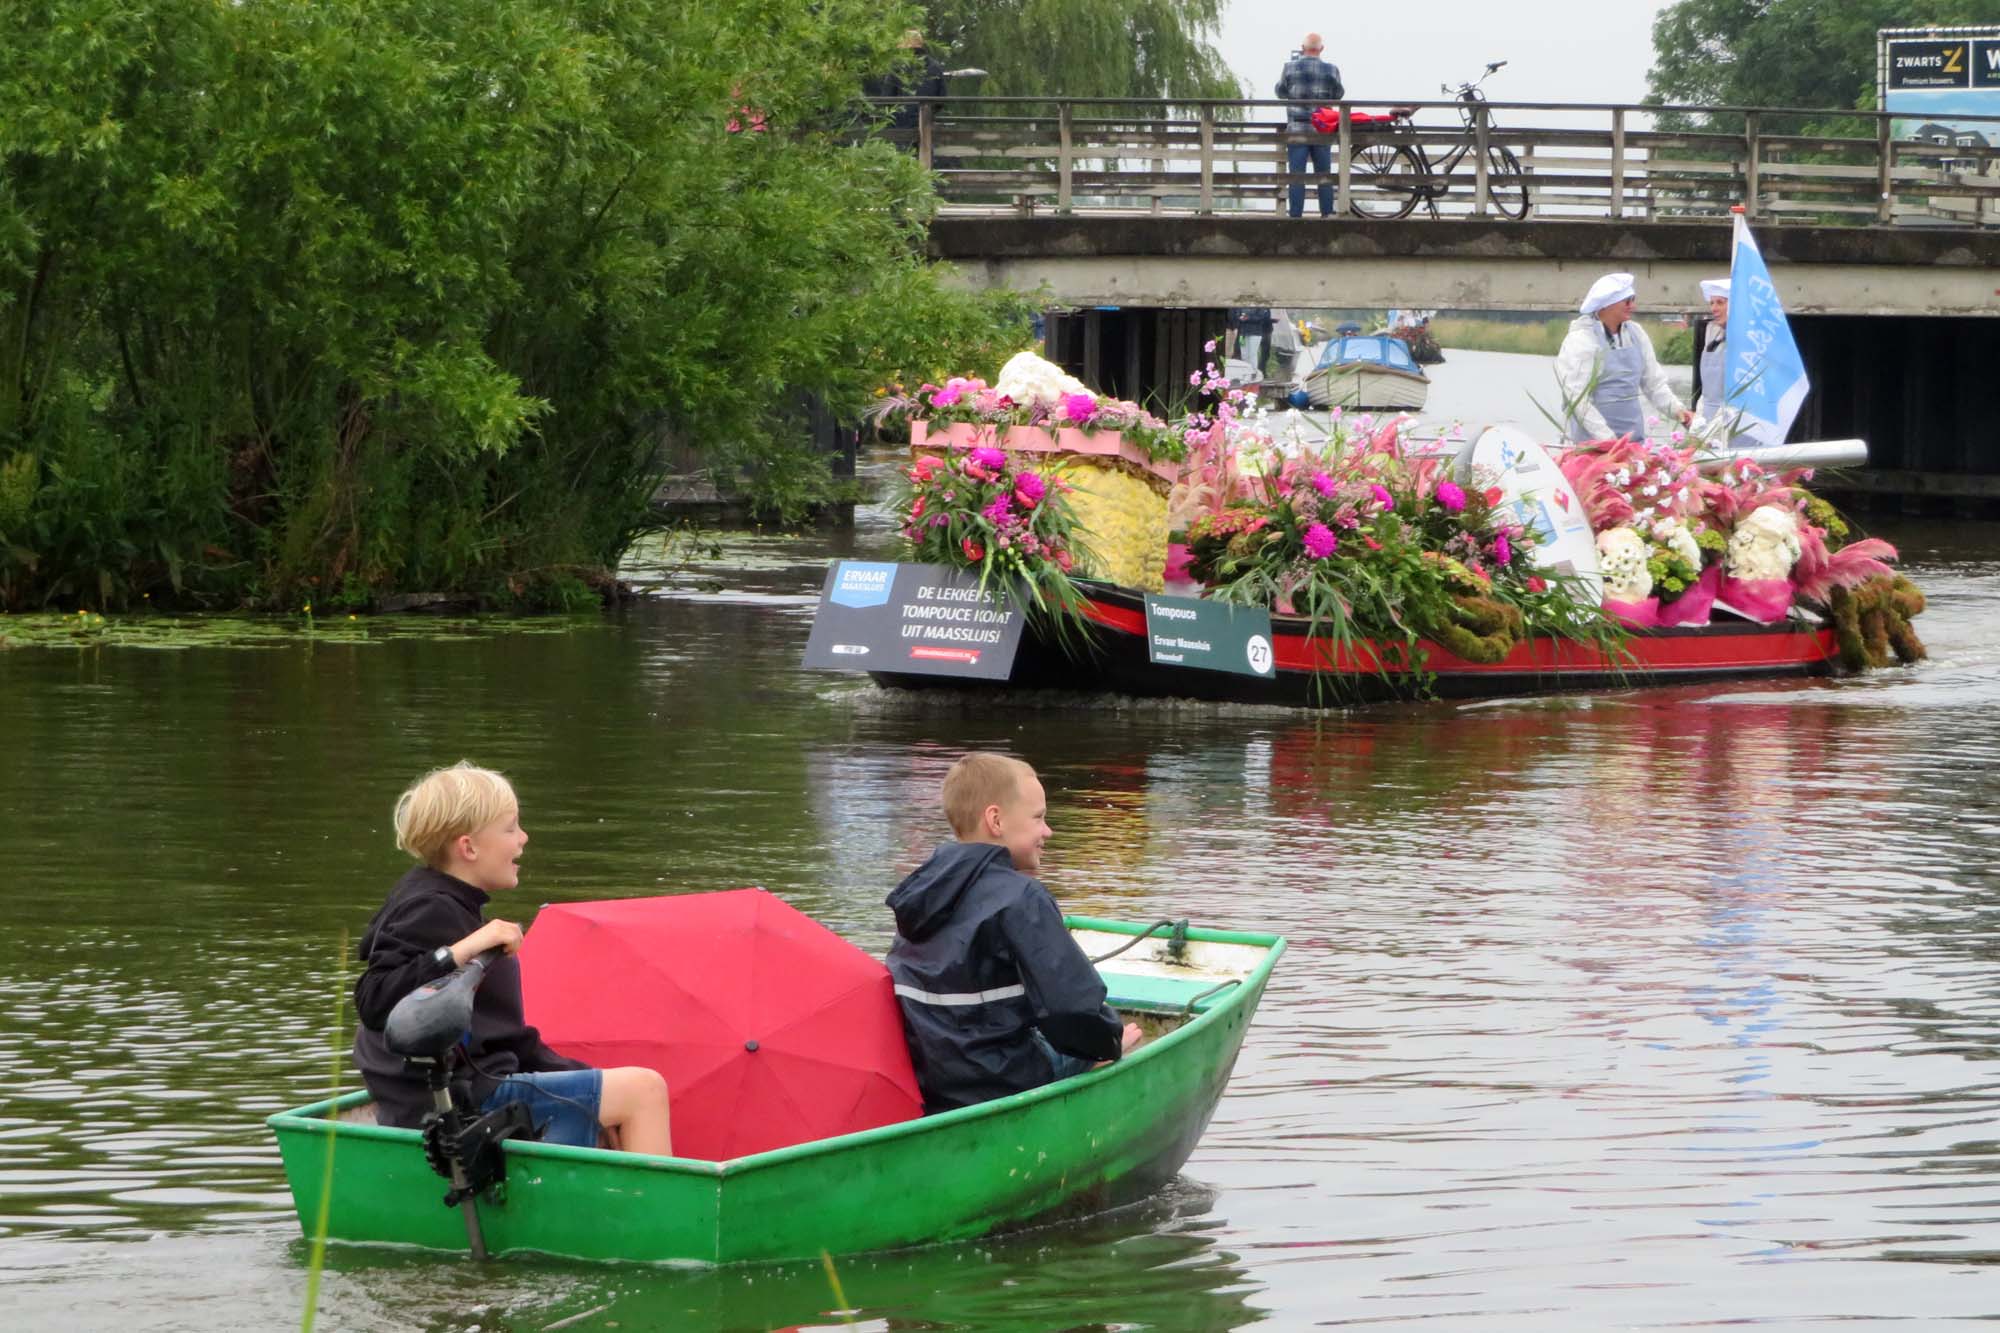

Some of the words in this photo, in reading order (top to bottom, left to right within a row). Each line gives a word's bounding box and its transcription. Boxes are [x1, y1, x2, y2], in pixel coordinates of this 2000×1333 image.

[1896, 56, 1942, 68] ZWARTS
[843, 569, 888, 583] ERVAAR
[917, 586, 934, 600] DE
[902, 605, 971, 621] TOMPOUCE
[1151, 603, 1197, 620] Tompouce
[902, 625, 921, 638] UIT
[924, 626, 1000, 643] MAASSLUIS!
[1251, 645, 1268, 663] 27
